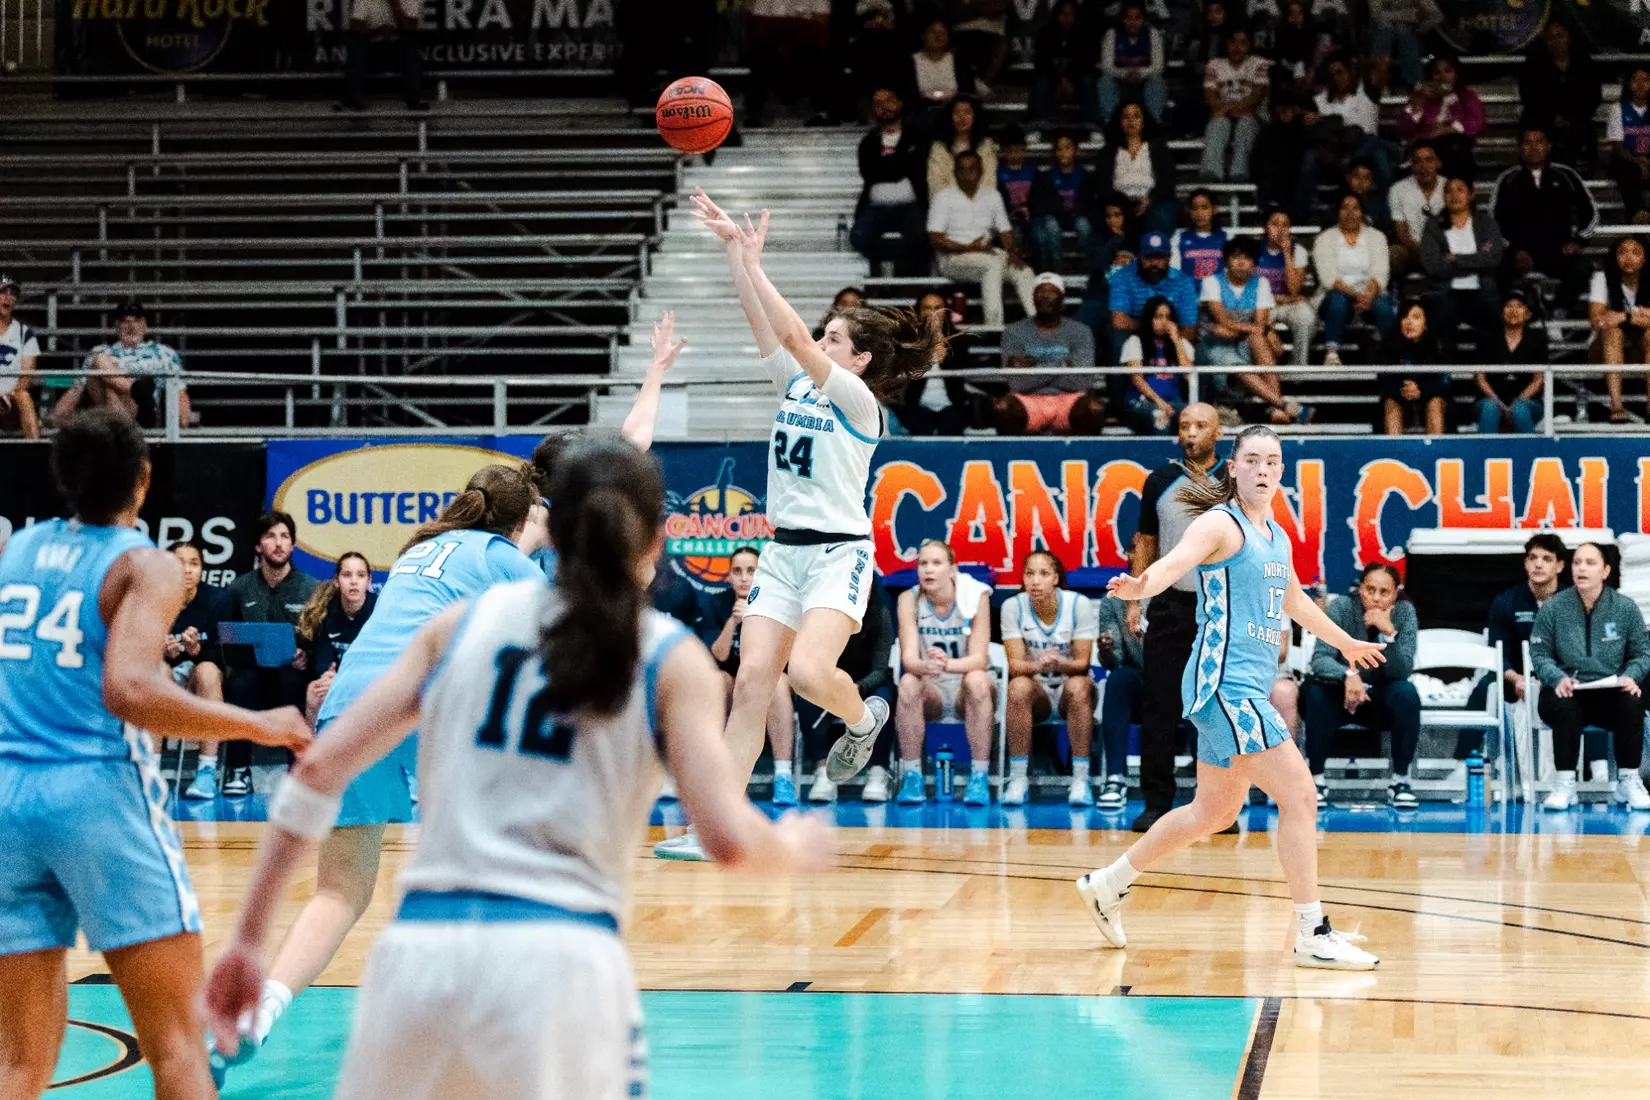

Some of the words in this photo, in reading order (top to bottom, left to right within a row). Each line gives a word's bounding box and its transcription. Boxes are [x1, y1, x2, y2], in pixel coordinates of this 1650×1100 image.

[661, 104, 712, 120] Wilson
[774, 429, 814, 479] 24
[392, 540, 462, 580] 21
[848, 549, 869, 605] LIONS
[0, 584, 84, 668] 24
[1266, 586, 1285, 619] 17
[475, 643, 578, 766] 12
